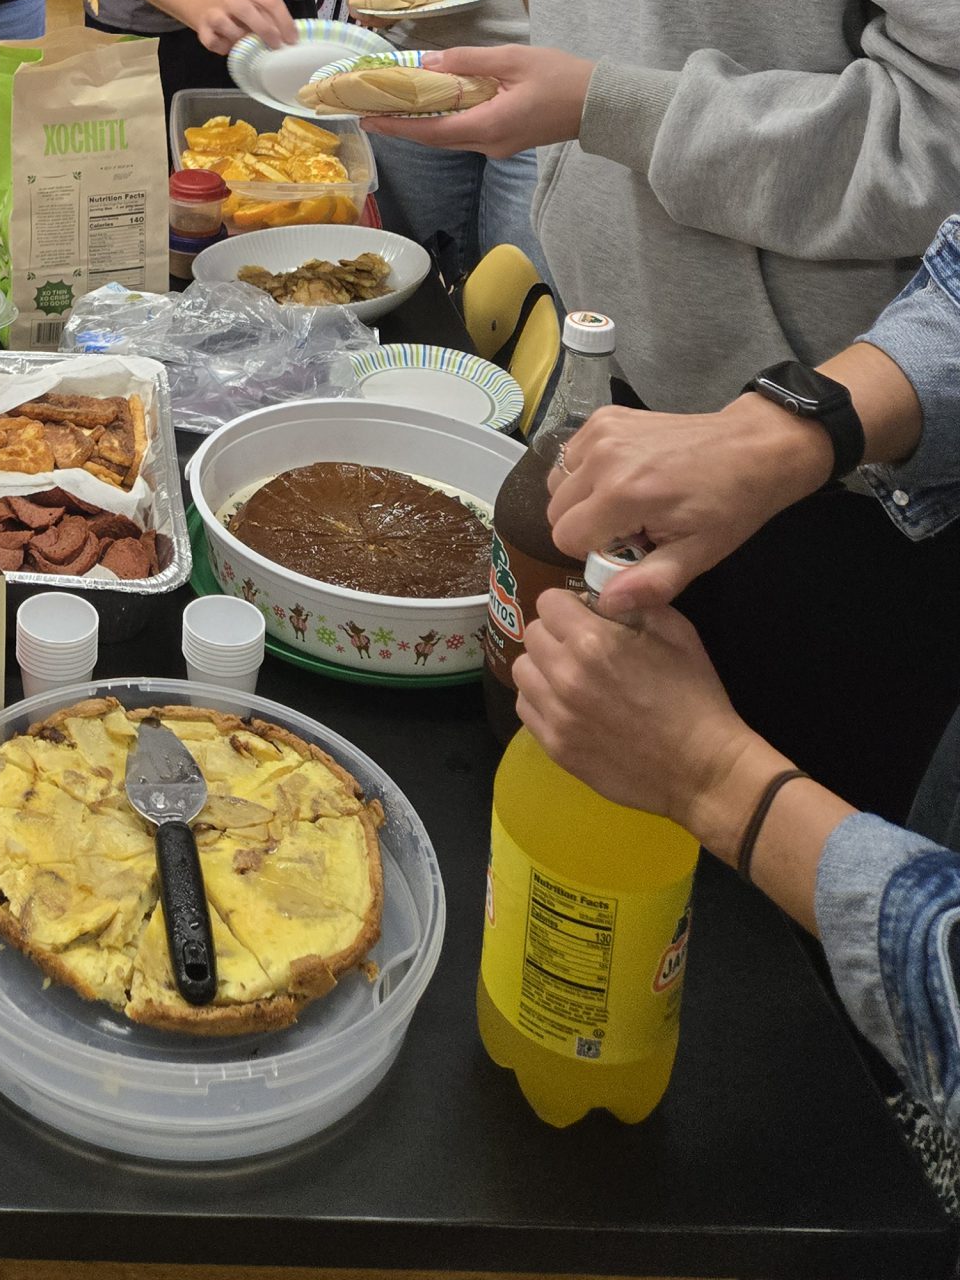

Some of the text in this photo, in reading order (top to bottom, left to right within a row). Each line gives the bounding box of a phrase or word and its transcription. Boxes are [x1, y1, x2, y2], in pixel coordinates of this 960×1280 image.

[90, 192, 145, 203] Nutrition Facts
[130, 216, 144, 224] 140
[534, 872, 609, 910] Nutrition Facts
[595, 932, 612, 946] 130
